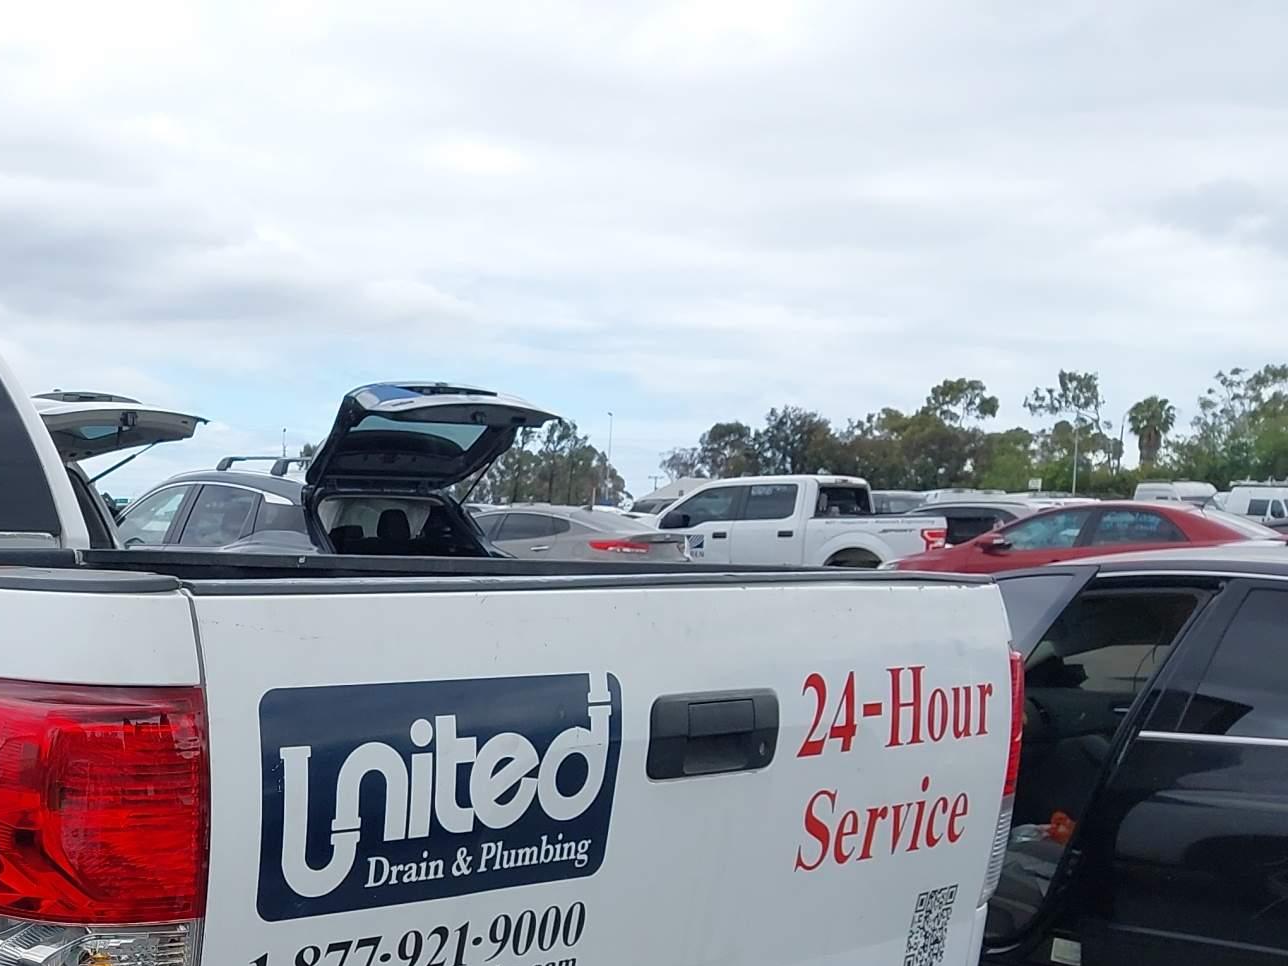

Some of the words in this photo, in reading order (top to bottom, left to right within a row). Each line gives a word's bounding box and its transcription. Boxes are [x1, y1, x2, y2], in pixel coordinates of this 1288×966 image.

[796, 665, 993, 759] 24-Hour
[279, 673, 612, 898] United
[794, 776, 969, 872] Service
[364, 851, 445, 889] Drain
[451, 846, 473, 877] &
[477, 832, 592, 874] Plumbing
